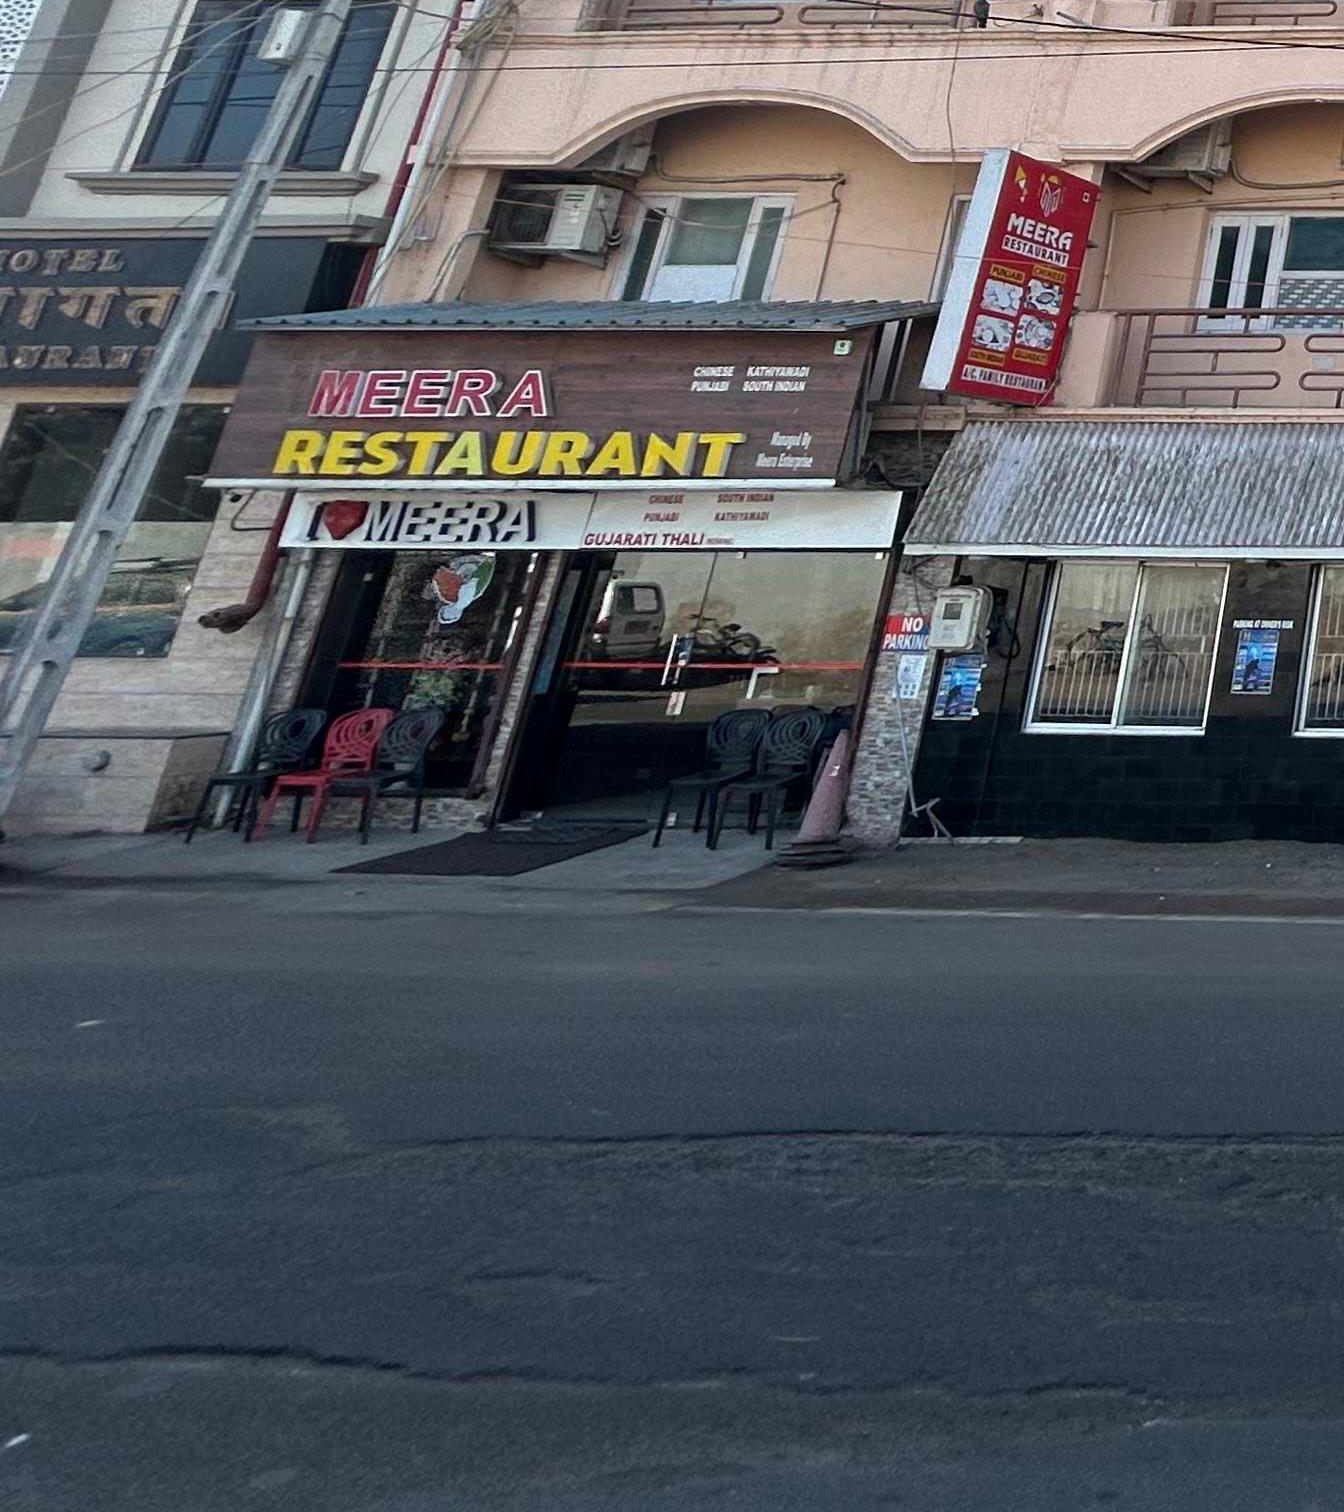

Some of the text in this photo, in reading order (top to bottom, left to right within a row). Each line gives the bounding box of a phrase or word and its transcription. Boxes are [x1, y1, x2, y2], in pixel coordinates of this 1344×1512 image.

[1007, 212, 1073, 252] MEERA
[1004, 236, 1068, 266] RESTAURANT
[694, 366, 735, 377] CHINESE
[308, 369, 549, 418] MEERA
[742, 381, 774, 392] SOUTH
[774, 381, 806, 392] INDIAN
[272, 430, 747, 478] RESTAURANT
[648, 494, 774, 504] CHINESE SOUTH INDIAN
[363, 500, 537, 543] MEERA
[643, 513, 679, 522] PUNJABI
[584, 532, 657, 545] GUJARATI
[662, 532, 704, 545] THALI
[902, 617, 923, 632] NO
